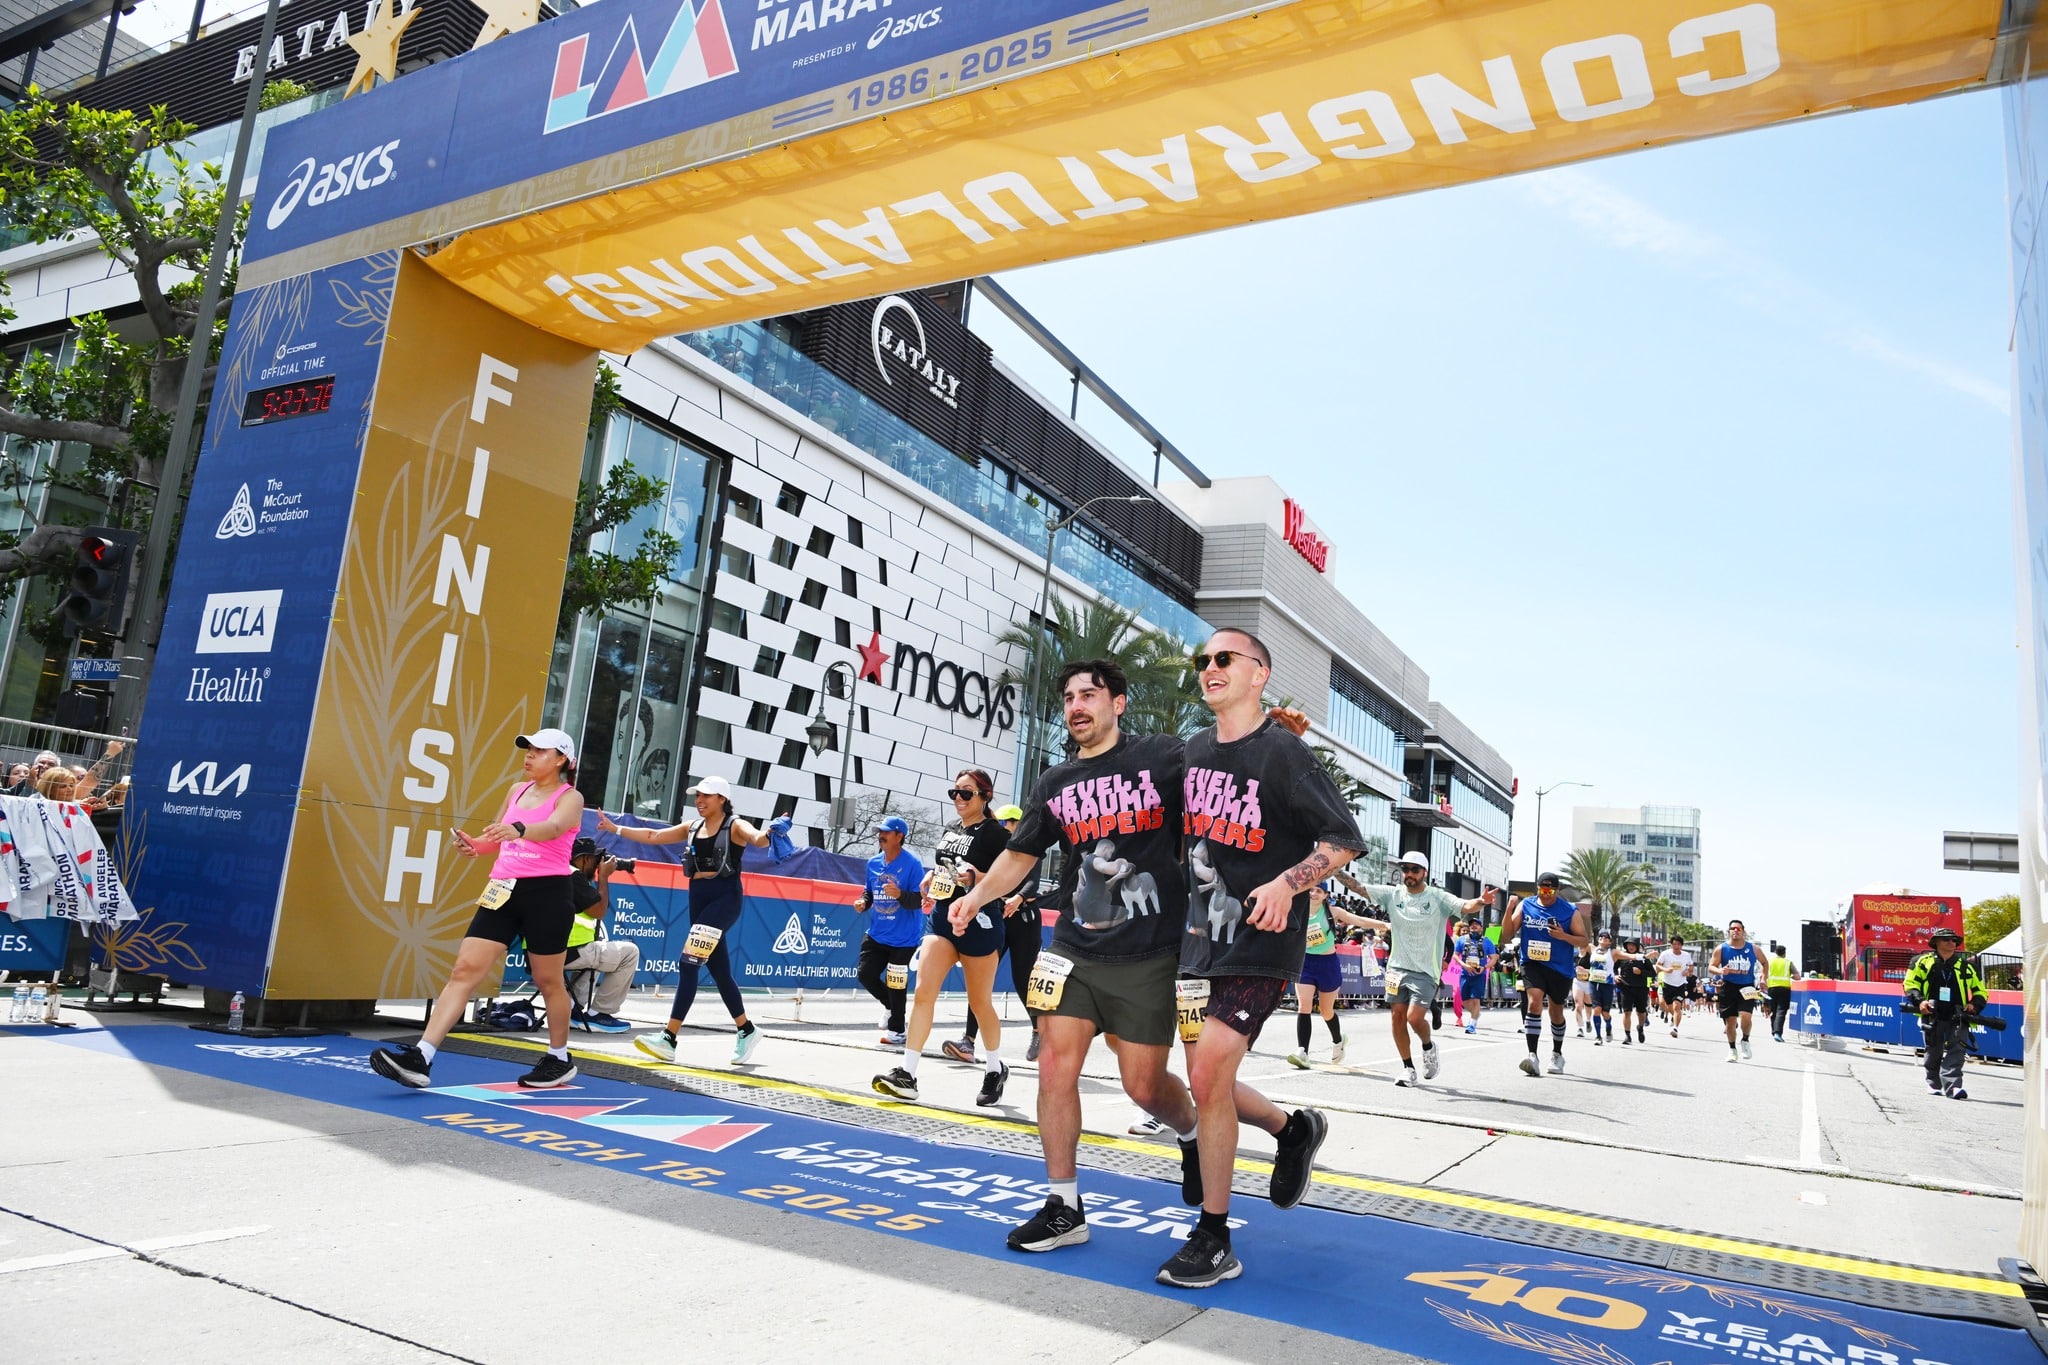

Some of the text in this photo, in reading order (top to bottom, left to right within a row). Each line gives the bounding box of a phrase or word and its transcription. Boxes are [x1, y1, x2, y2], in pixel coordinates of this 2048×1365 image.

[792, 41, 857, 69] PRESENTED BY
[847, 67, 929, 111] 1986
[960, 31, 1053, 81] 2025
[545, 3, 1781, 324] CONGRATULATIONS!
[260, 356, 326, 380] OFFICIAL TIME
[880, 325, 961, 397] EATALY
[267, 479, 283, 491] The
[263, 493, 302, 507] McCourt
[260, 509, 309, 523] Foundation
[1283, 498, 1330, 573] Westfield
[210, 605, 265, 638] UCLA
[384, 352, 519, 904] FINISH
[72, 661, 121, 672] Ave Of The Stars
[185, 667, 264, 702] Health
[162, 802, 242, 821] Movement that inspires
[97, 849, 107, 899] ANGELES
[617, 898, 635, 909] The
[615, 912, 657, 925] McCourt
[814, 914, 827, 925] The
[1872, 924, 1884, 933] Hop
[613, 925, 665, 938] Foundation
[813, 926, 841, 937] McCourt
[811, 938, 847, 948] Foundation
[745, 963, 773, 976] BUILD
[775, 964, 783, 976] A
[784, 965, 829, 978] HEALTHIER
[1867, 1005, 1893, 1017] ULTRA
[422, 1113, 726, 1187] MARCH 16,
[803, 1141, 921, 1166] LOS
[790, 1173, 880, 1194] PRESENTED
[738, 1184, 944, 1231] 2025
[1404, 1271, 1647, 1331] 40
